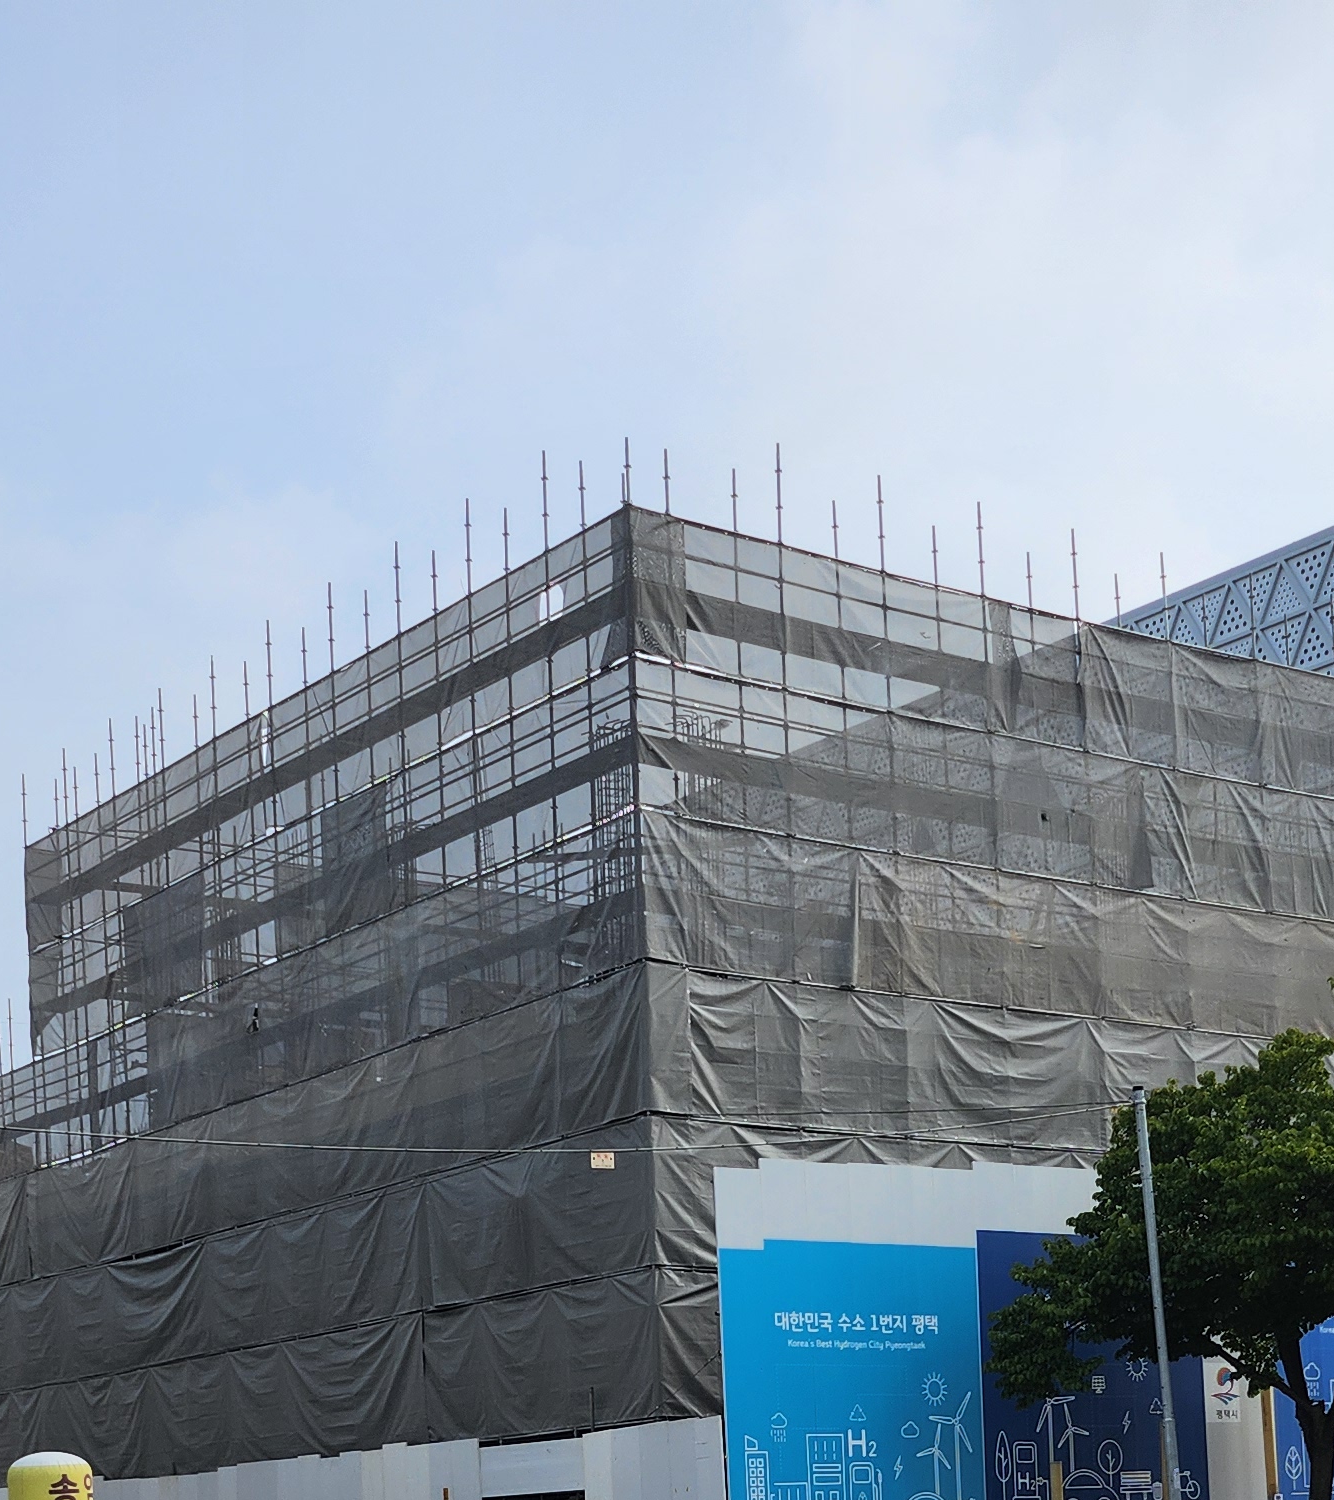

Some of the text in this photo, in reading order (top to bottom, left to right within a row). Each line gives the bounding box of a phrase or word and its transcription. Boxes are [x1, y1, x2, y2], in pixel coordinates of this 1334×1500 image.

[774, 1311, 939, 1335] 대한민국 수소 1번지 평택
[787, 1339, 926, 1351] Korea's Best Hydrogen City Pyeongtaek
[1215, 1409, 1239, 1420] 평택시
